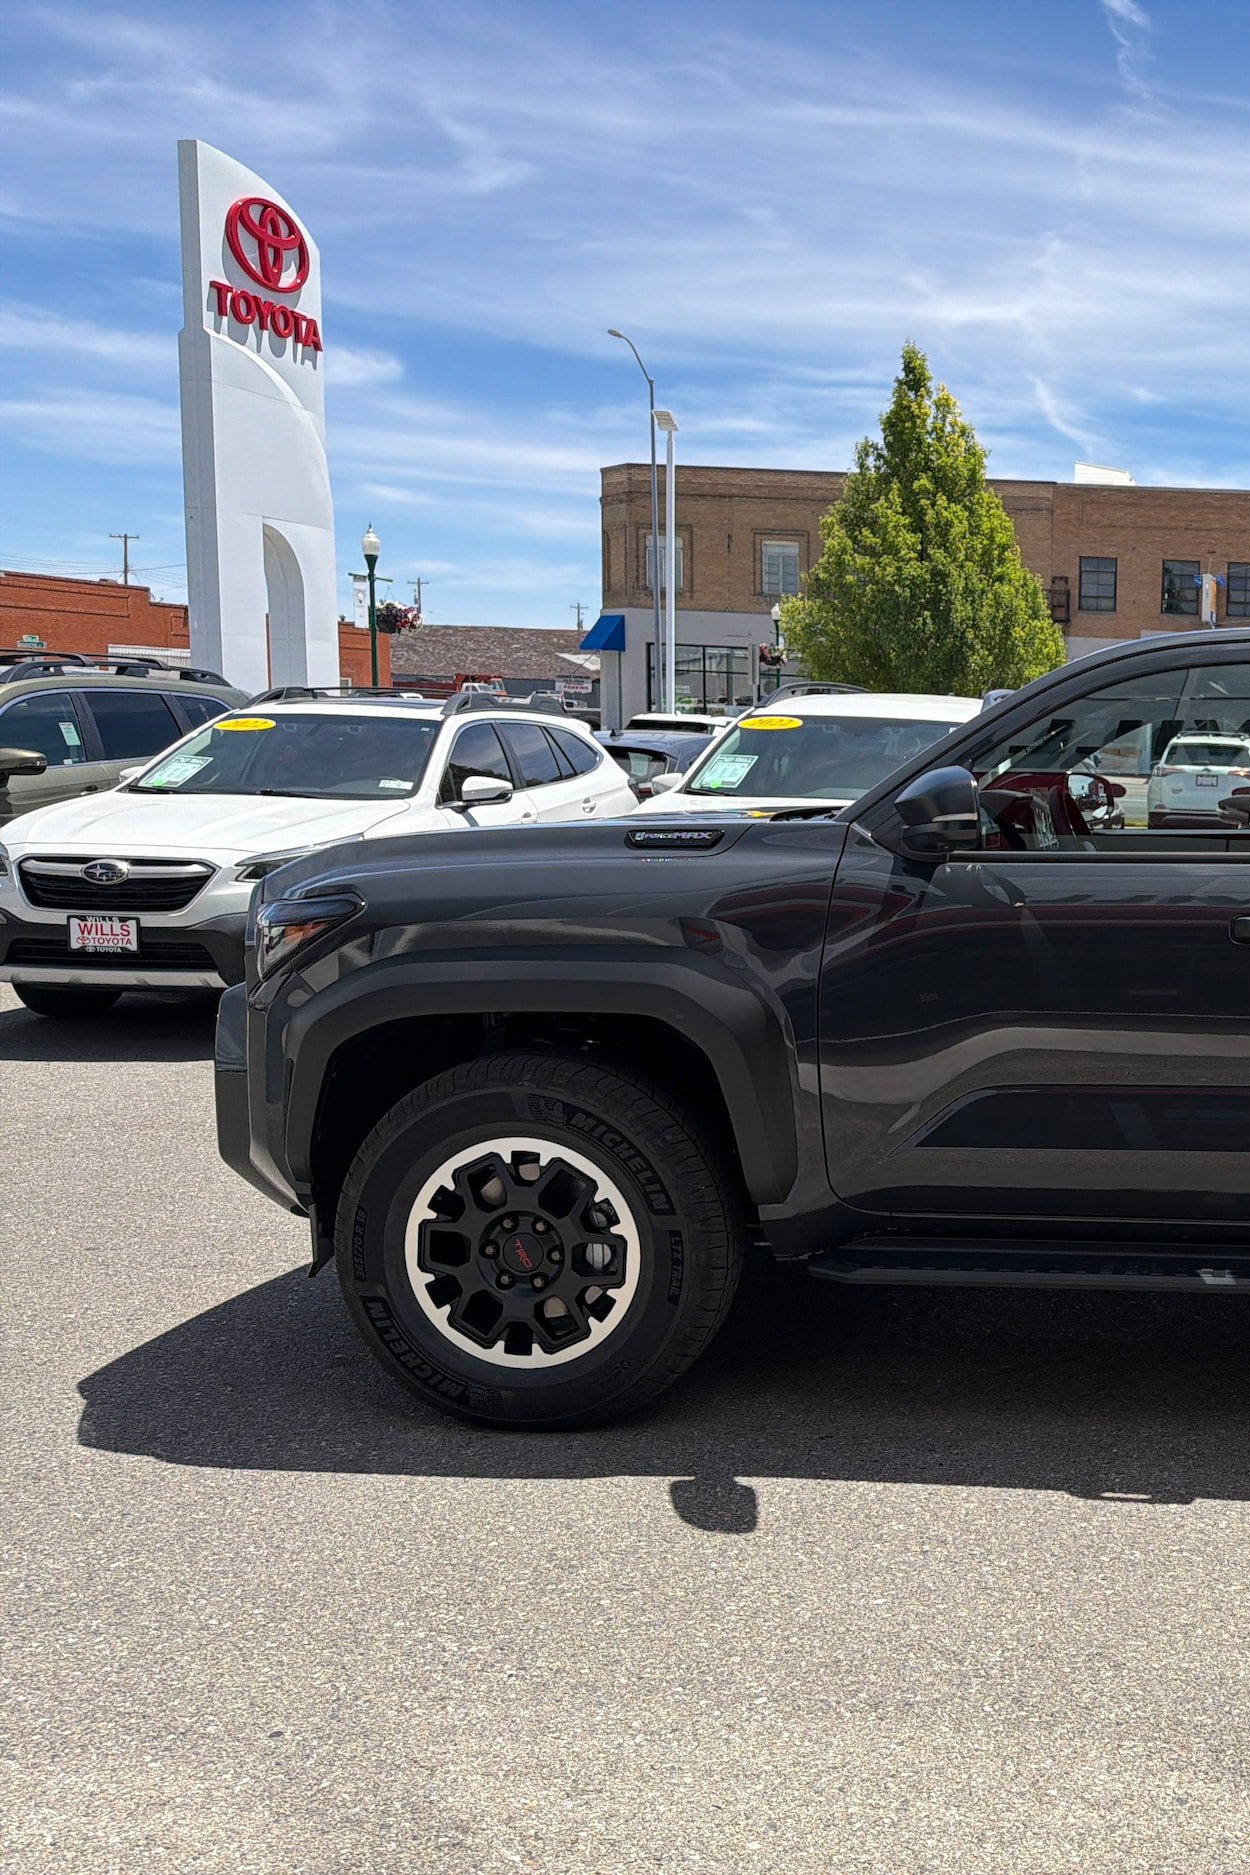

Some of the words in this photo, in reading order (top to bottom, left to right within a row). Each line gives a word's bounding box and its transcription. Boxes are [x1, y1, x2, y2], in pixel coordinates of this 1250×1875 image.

[209, 280, 323, 352] TOYOTA
[77, 922, 131, 937] WILLS
[86, 915, 120, 923] WILLS
[91, 937, 133, 946] TOYOTA
[569, 1110, 671, 1210] MICHELIN
[515, 1238, 533, 1269] TRD
[366, 1301, 463, 1399] MICHELIN
